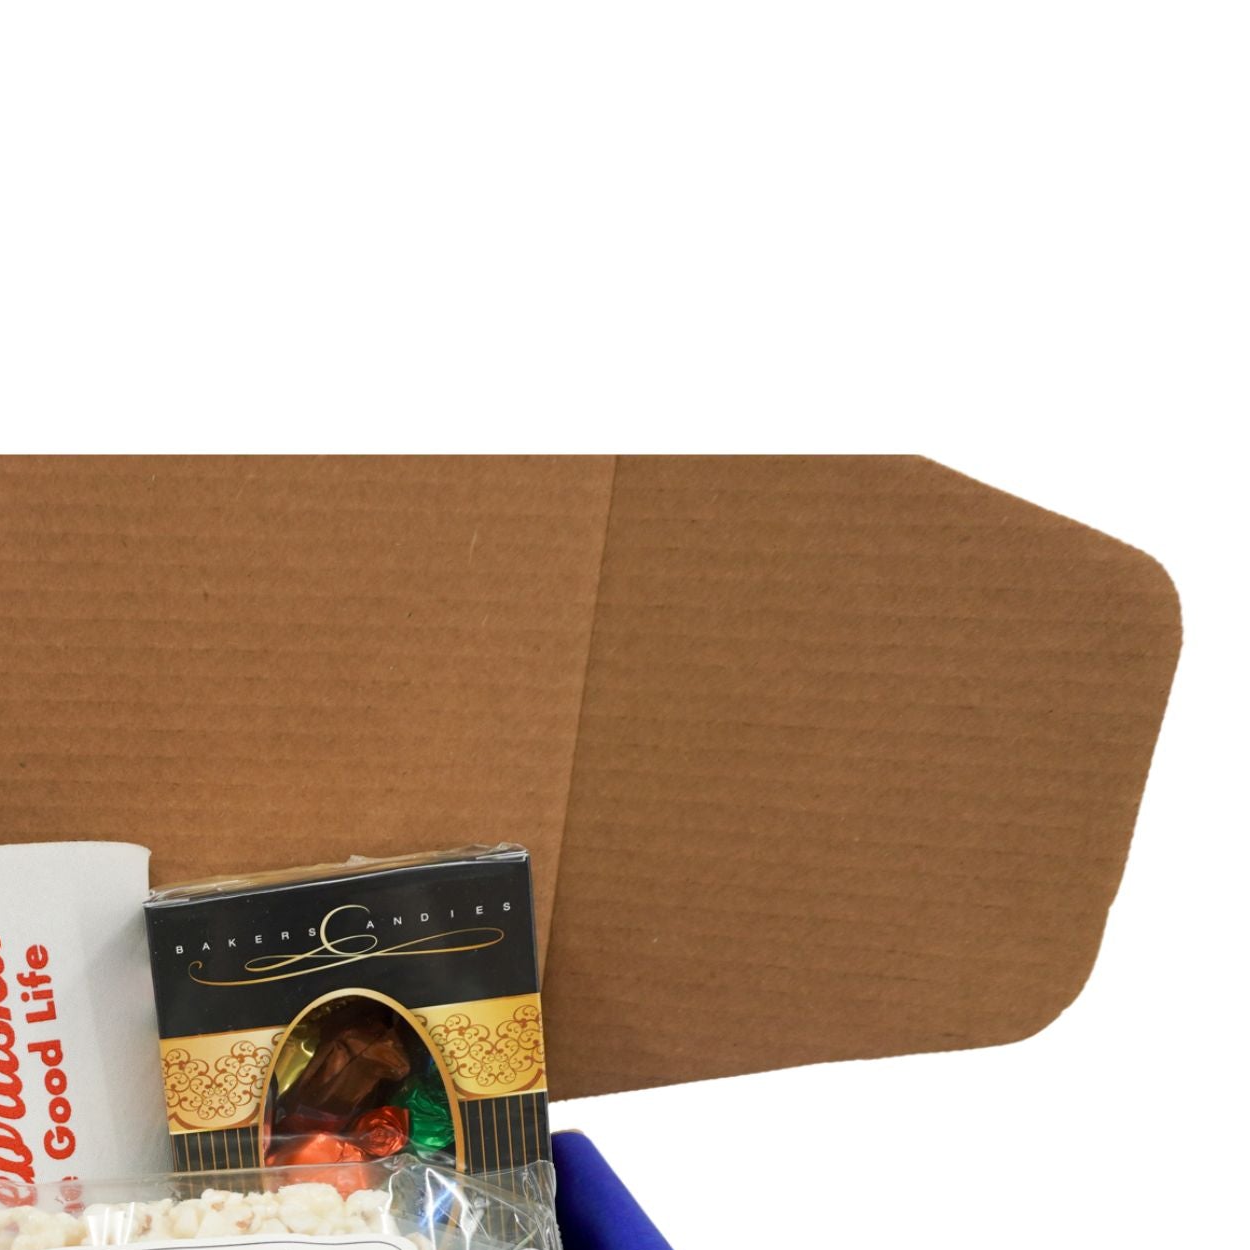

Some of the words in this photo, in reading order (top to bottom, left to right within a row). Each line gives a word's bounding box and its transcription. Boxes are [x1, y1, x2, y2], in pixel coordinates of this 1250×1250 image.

[176, 928, 316, 955] BAKERS
[16, 944, 57, 1024] Life
[28, 1039, 76, 1161] Good
